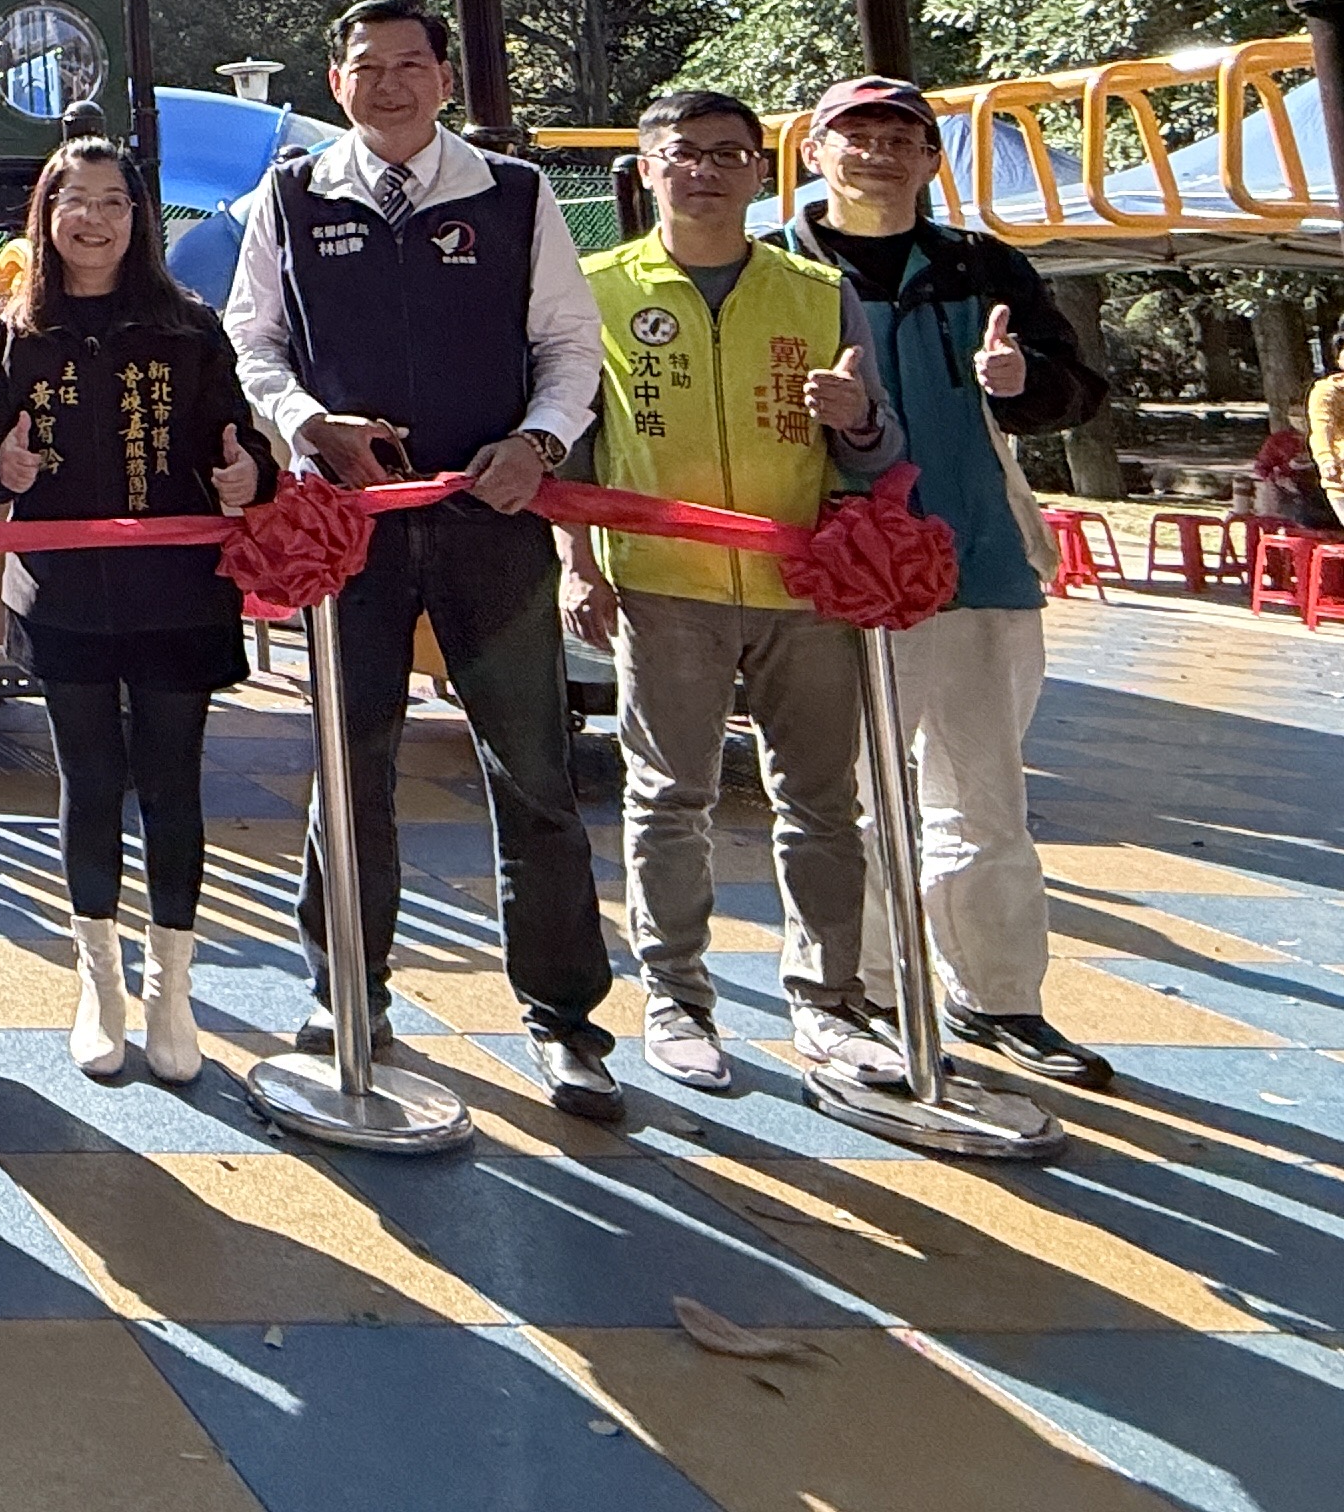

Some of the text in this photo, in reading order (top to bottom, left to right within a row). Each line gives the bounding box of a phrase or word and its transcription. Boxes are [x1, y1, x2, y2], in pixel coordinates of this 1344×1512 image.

[58, 361, 79, 405] 主任
[147, 360, 173, 476] 新北市議員
[628, 350, 667, 438] 沈中皓
[667, 352, 691, 389] 特助
[768, 335, 811, 448] 戴瑋姍
[114, 362, 150, 512] 曾煥嘉服務團隊
